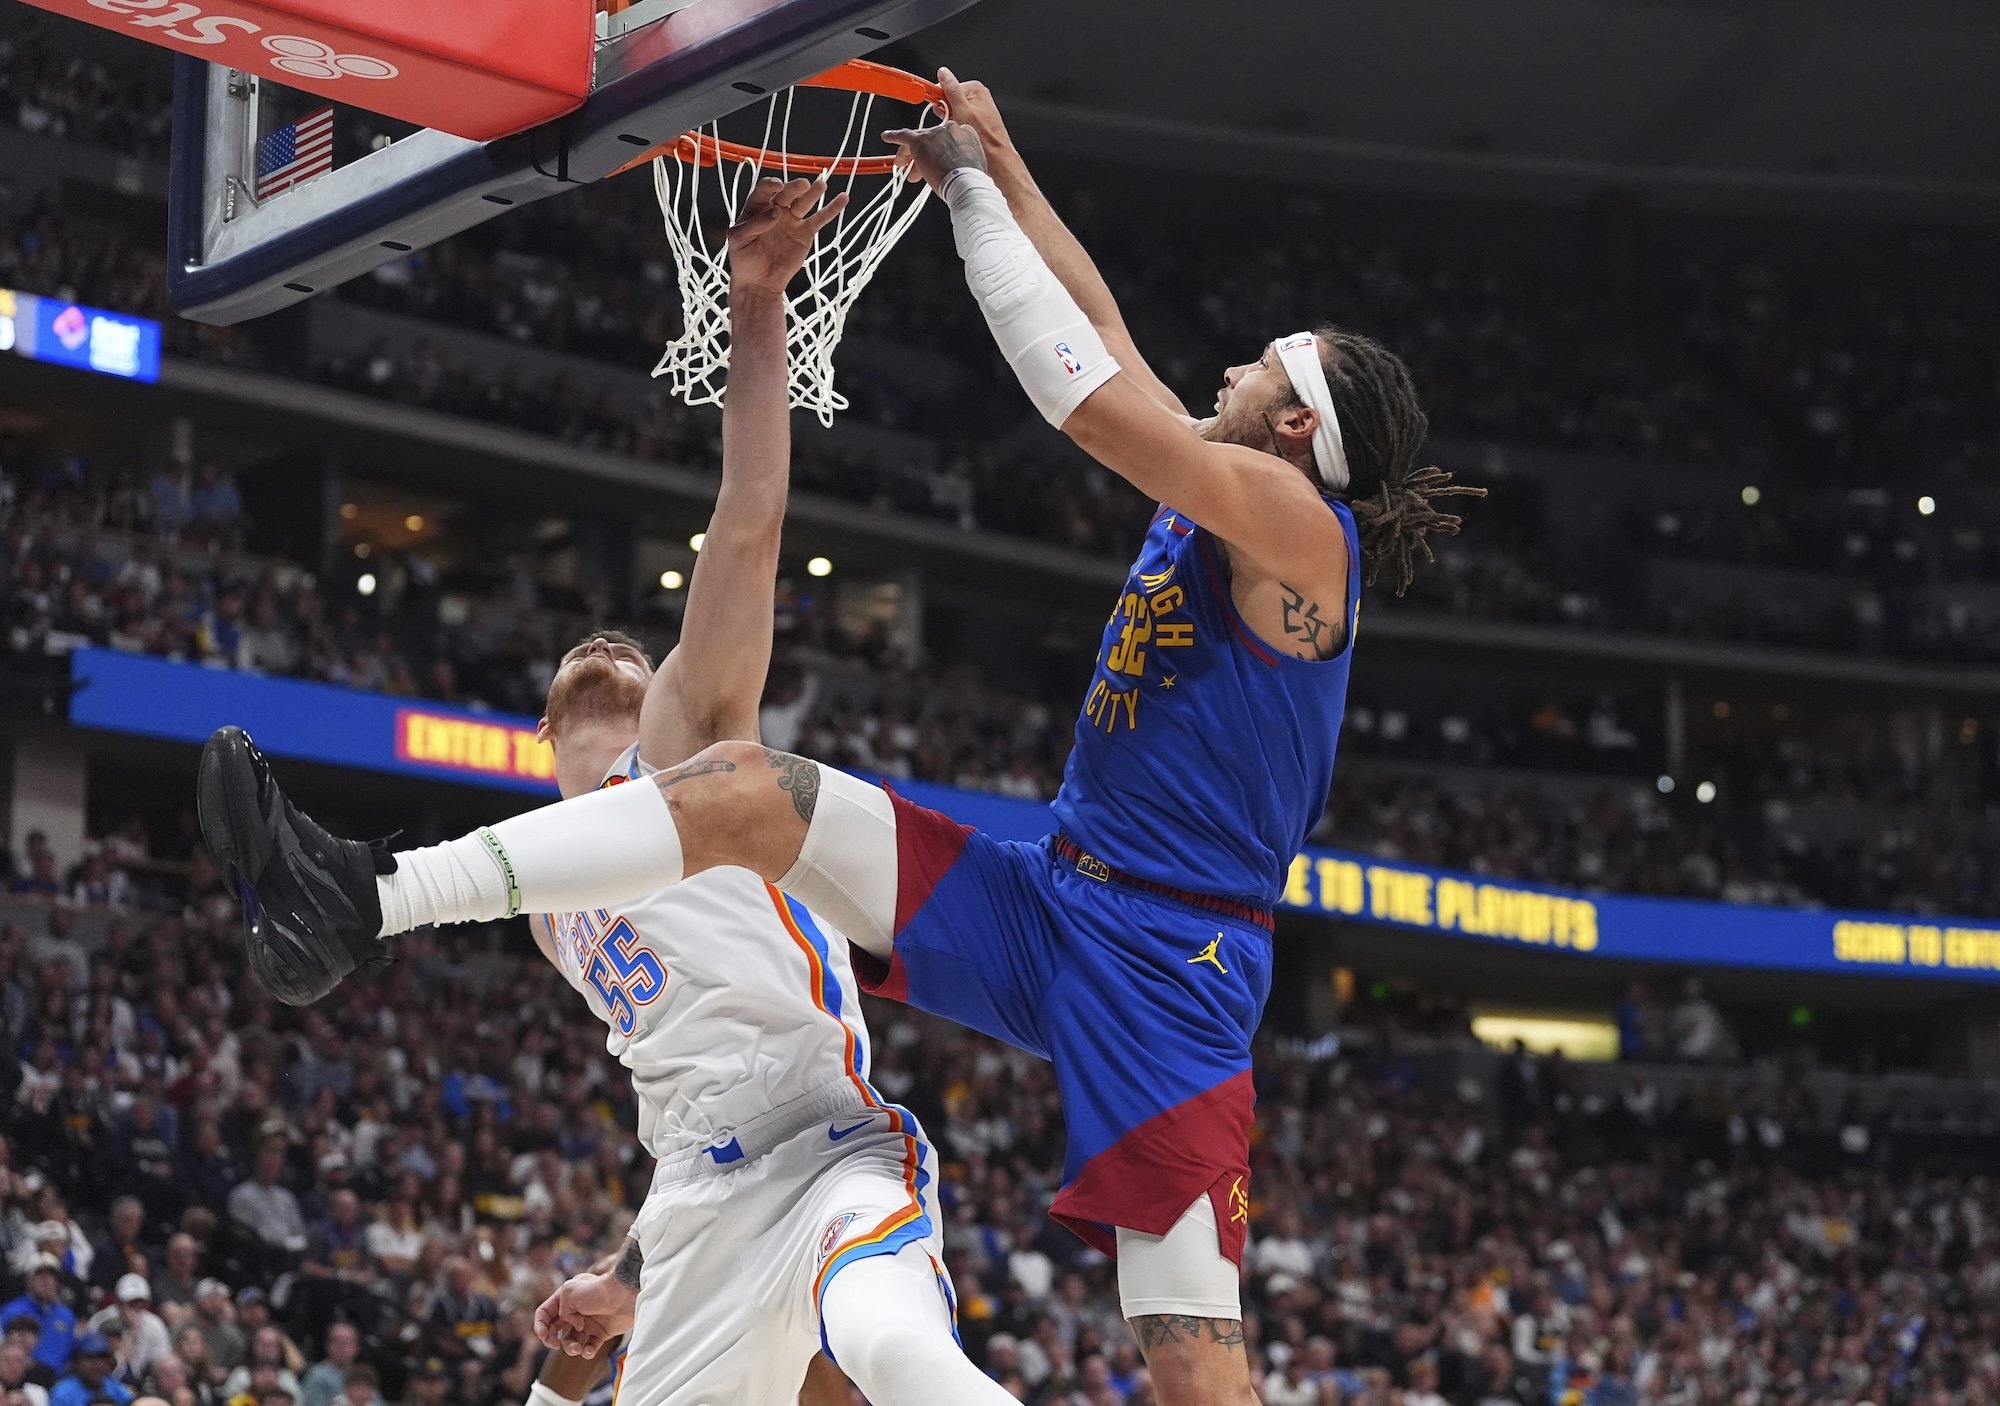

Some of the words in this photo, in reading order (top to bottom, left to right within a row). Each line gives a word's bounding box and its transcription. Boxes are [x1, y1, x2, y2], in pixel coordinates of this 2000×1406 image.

[1107, 592, 1152, 677] 32
[1086, 678, 1139, 734] CITY
[407, 713, 508, 772] ENTER
[498, 849, 518, 890] NBA
[1316, 857, 1364, 915] TO
[1366, 866, 1433, 926] THE
[1436, 877, 1598, 952] PLAYOFFS
[1832, 919, 1906, 965] SCAN
[1908, 924, 1942, 967] TO
[583, 915, 668, 1037] 55
